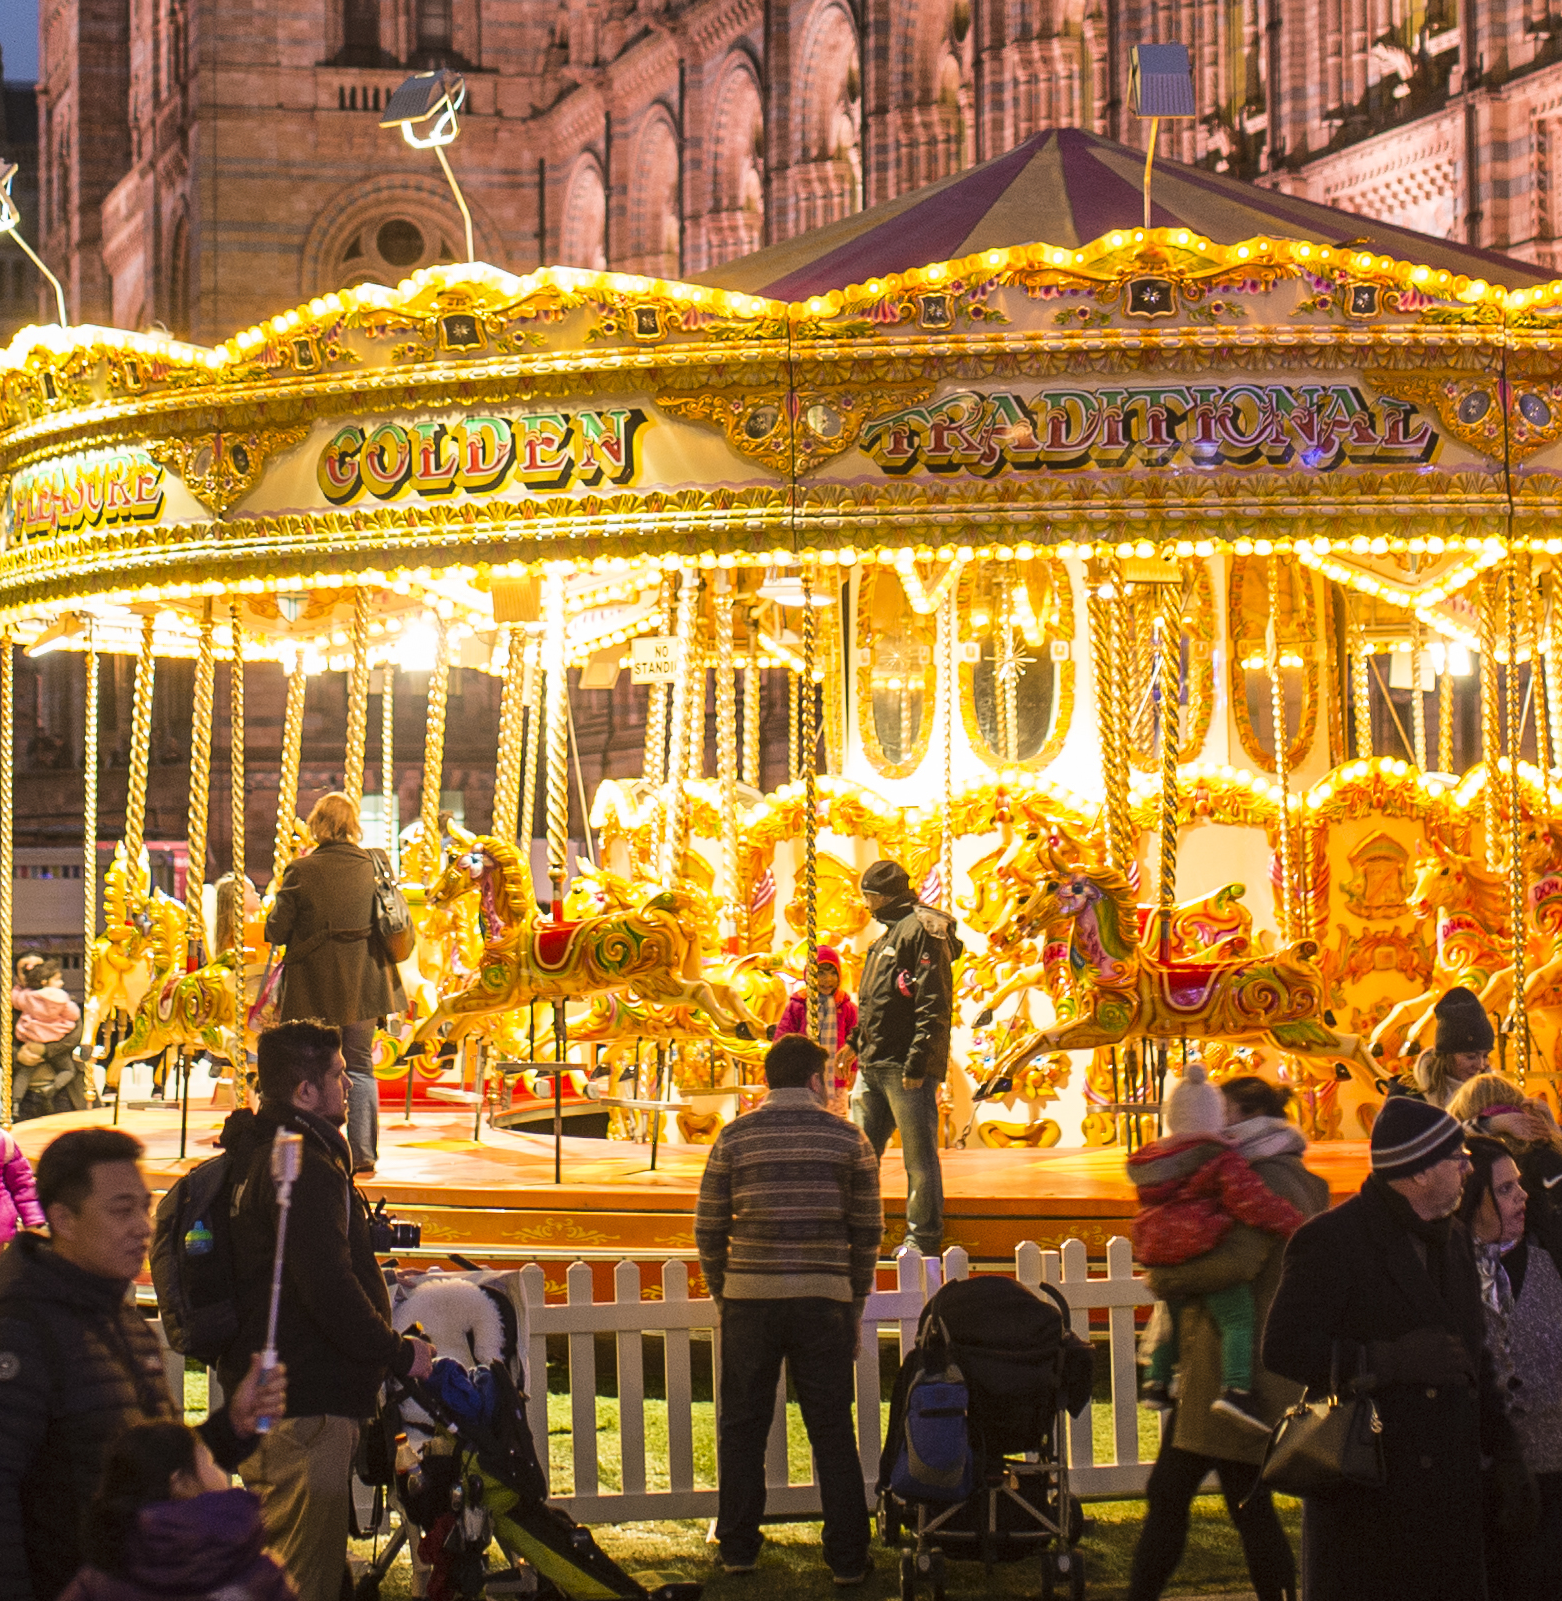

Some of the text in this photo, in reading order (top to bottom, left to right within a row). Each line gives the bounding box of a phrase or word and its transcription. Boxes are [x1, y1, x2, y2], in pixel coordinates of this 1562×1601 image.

[318, 408, 642, 504] GOLDEN
[861, 384, 1438, 478] TRADITIONAL
[13, 451, 165, 541] PLEASURE
[634, 661, 678, 675] STANDI
[654, 645, 669, 658] NO
